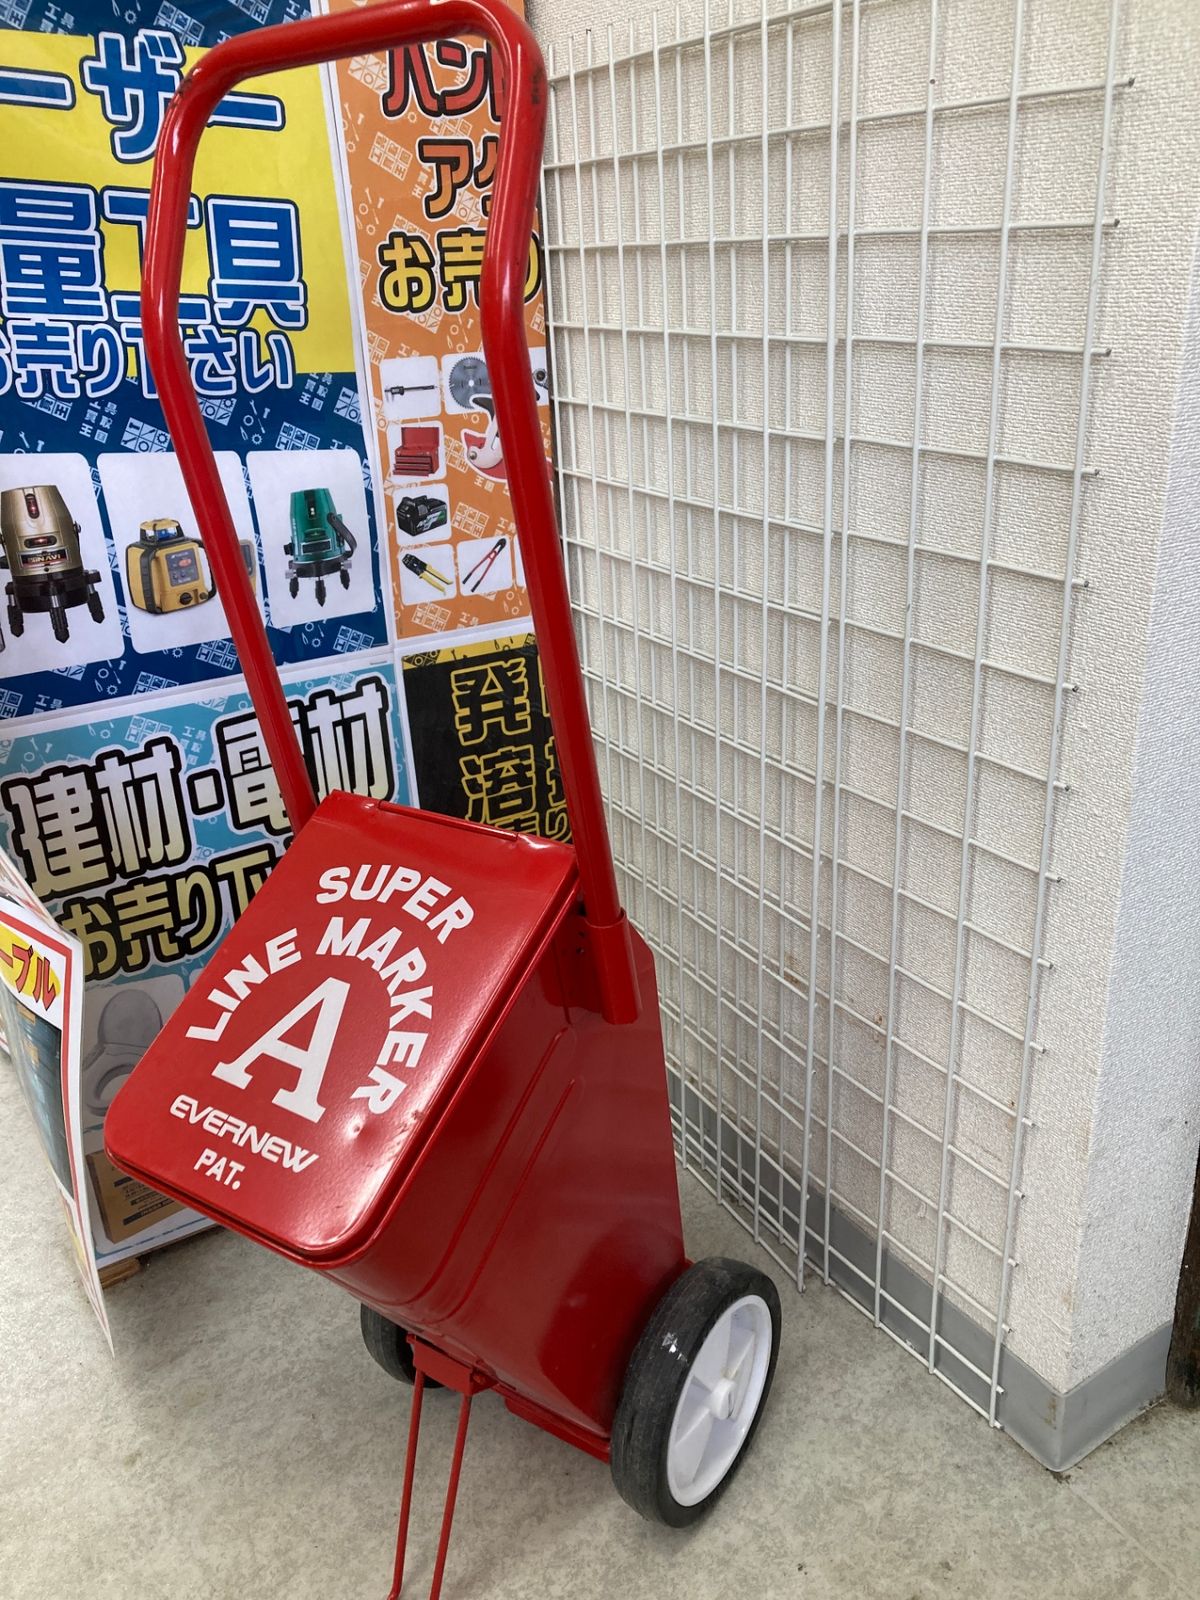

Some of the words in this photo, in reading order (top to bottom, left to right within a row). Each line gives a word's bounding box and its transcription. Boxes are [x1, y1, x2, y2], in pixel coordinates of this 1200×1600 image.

[316, 864, 474, 944] SUPER
[185, 928, 302, 1042] LINE
[316, 917, 433, 1115] MARKER
[211, 977, 351, 1124] A
[169, 1094, 320, 1173] EVERNEW
[194, 1148, 245, 1190] PAT.
